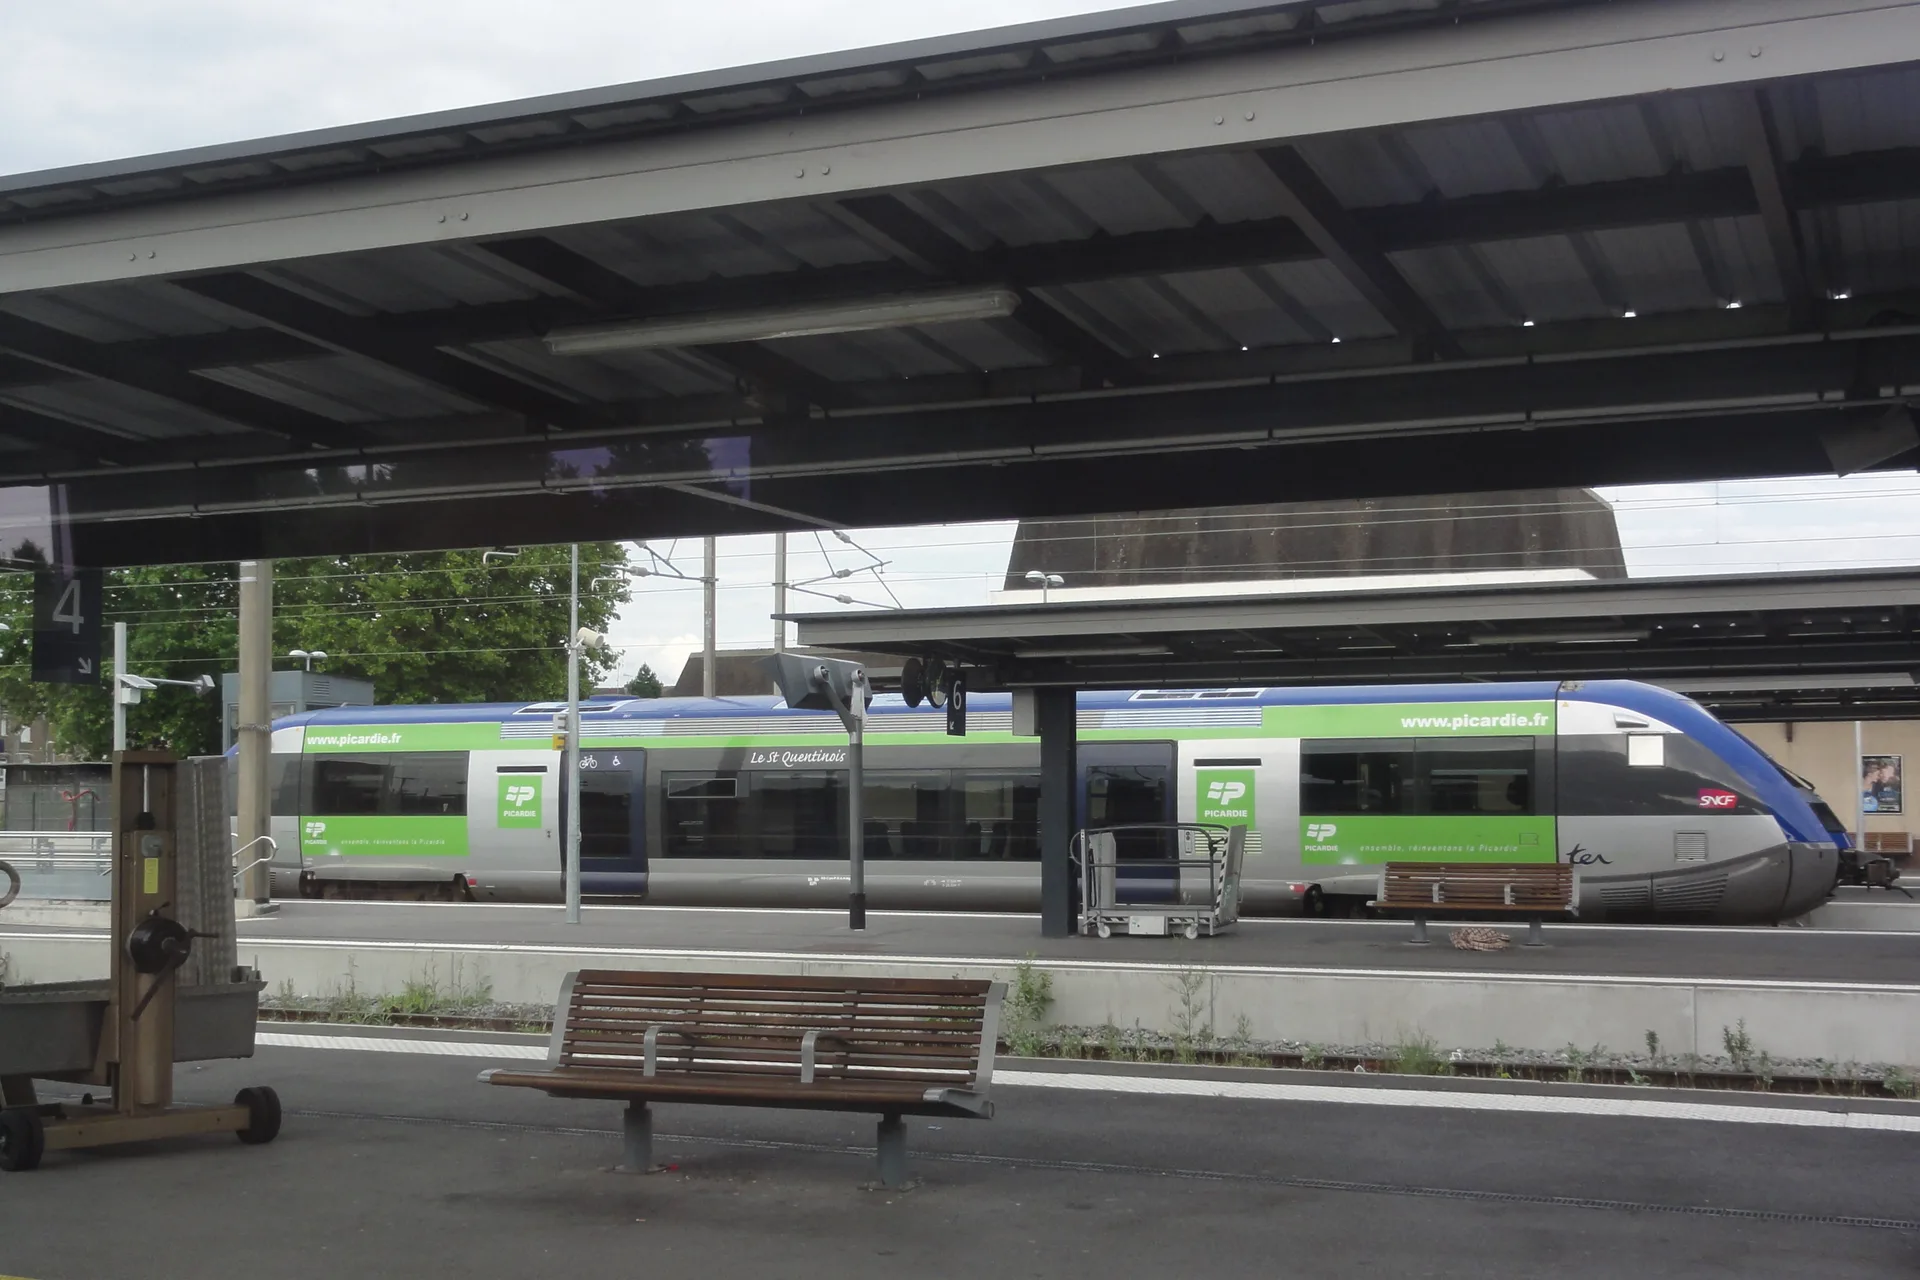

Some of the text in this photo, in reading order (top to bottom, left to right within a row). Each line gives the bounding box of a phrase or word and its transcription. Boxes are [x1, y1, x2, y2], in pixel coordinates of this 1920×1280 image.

[52, 579, 84, 634] 4
[953, 680, 962, 710] 6
[1401, 713, 1549, 730] www.picardie.fr
[306, 733, 402, 747] www.picardie.fr
[750, 749, 846, 767] Le St Quentinois
[1699, 795, 1736, 806] SNCF
[1204, 809, 1248, 817] PICARDIE
[1566, 843, 1614, 865] ter
